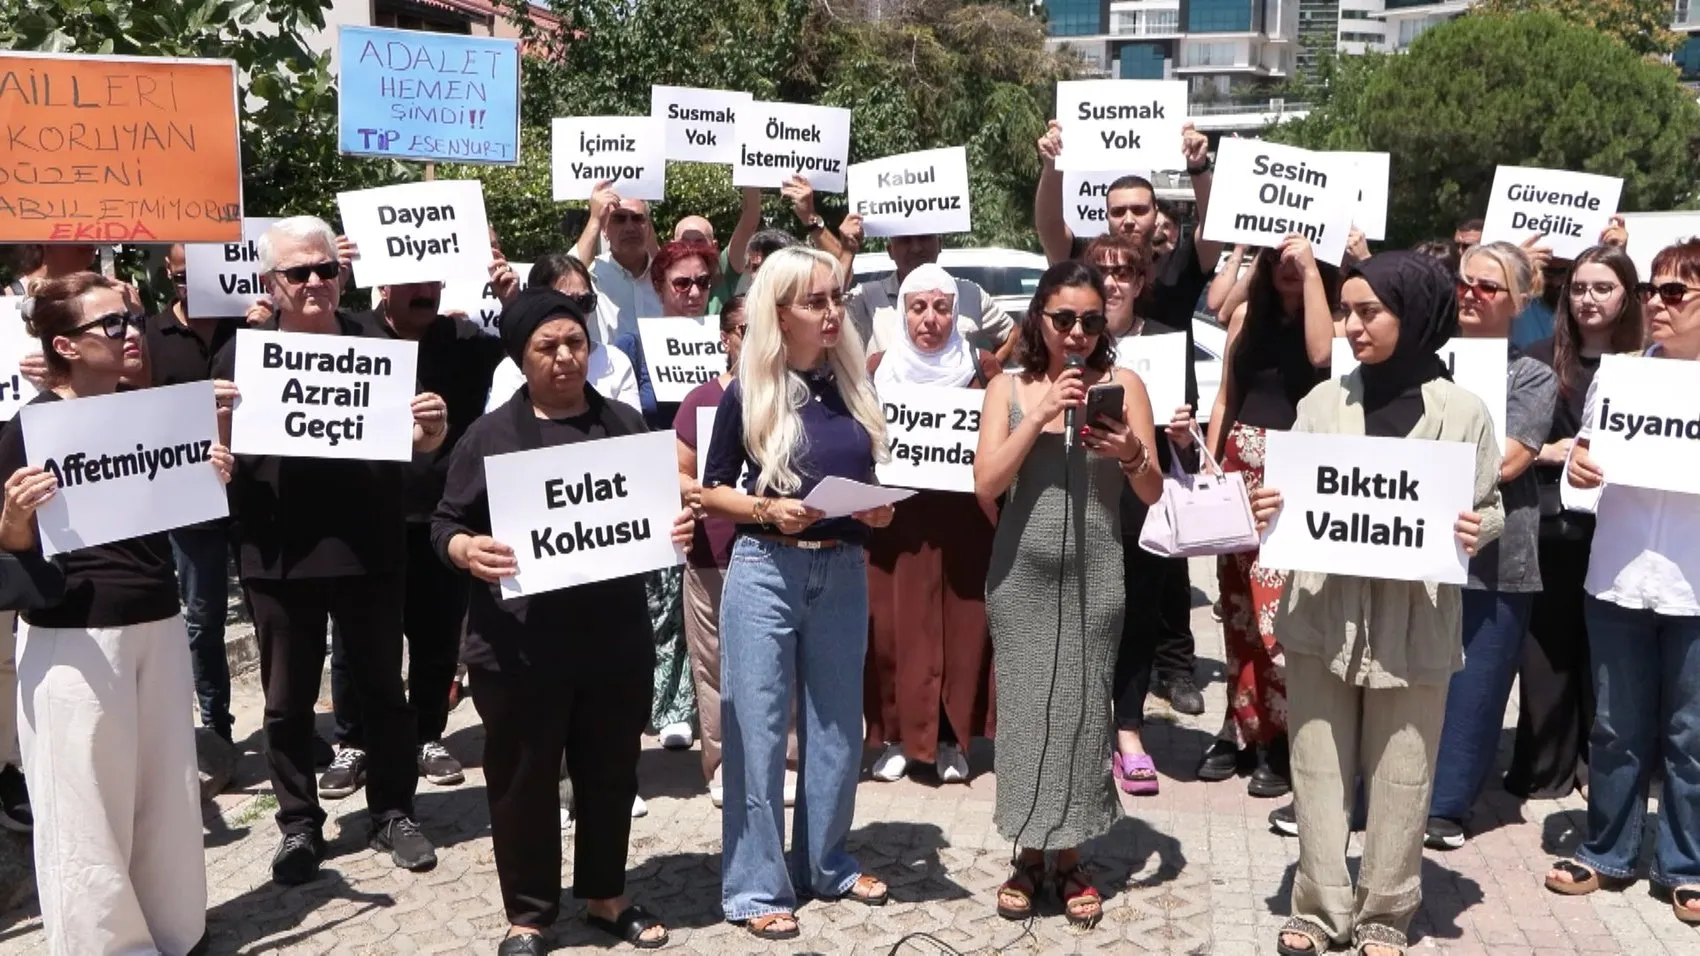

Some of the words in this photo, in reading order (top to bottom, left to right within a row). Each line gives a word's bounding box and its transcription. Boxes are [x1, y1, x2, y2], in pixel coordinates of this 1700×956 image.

[360, 39, 501, 80] ADALET
[381, 76, 486, 102] HEMEN
[668, 102, 735, 124] Susmak
[1077, 100, 1165, 121] Susmak
[7, 121, 196, 152] KORUYAN
[357, 128, 400, 150] TİP
[408, 134, 512, 158] ESENYURT
[579, 130, 636, 157] İçimiz
[685, 128, 717, 146] Yok
[765, 116, 821, 143] Ölmek
[1100, 129, 1141, 149] Yok
[571, 161, 645, 183] Yanıyor
[740, 143, 841, 174] İstemiyoruz
[1252, 154, 1328, 189] Sesim
[877, 165, 936, 189] Kabul
[856, 195, 961, 218] Etmiyoruz
[1258, 182, 1314, 211] Olur
[1507, 183, 1601, 212] Güvende
[50, 220, 157, 240] EKİDA
[377, 203, 456, 229] Dayan
[1234, 213, 1326, 245] musun!
[1511, 212, 1584, 238] Değiliz
[386, 232, 460, 262] Diyar!
[262, 342, 392, 376] Buradan
[281, 377, 370, 408] Azrail
[284, 411, 364, 446] Geçti
[882, 402, 947, 432] Diyar
[951, 408, 982, 432] 23
[43, 439, 212, 489] Affetmiyoruz
[544, 472, 629, 510] Evlat
[1316, 465, 1420, 502] Bıktık
[530, 517, 651, 560] Kokusu
[1305, 510, 1425, 549] Vallahi
